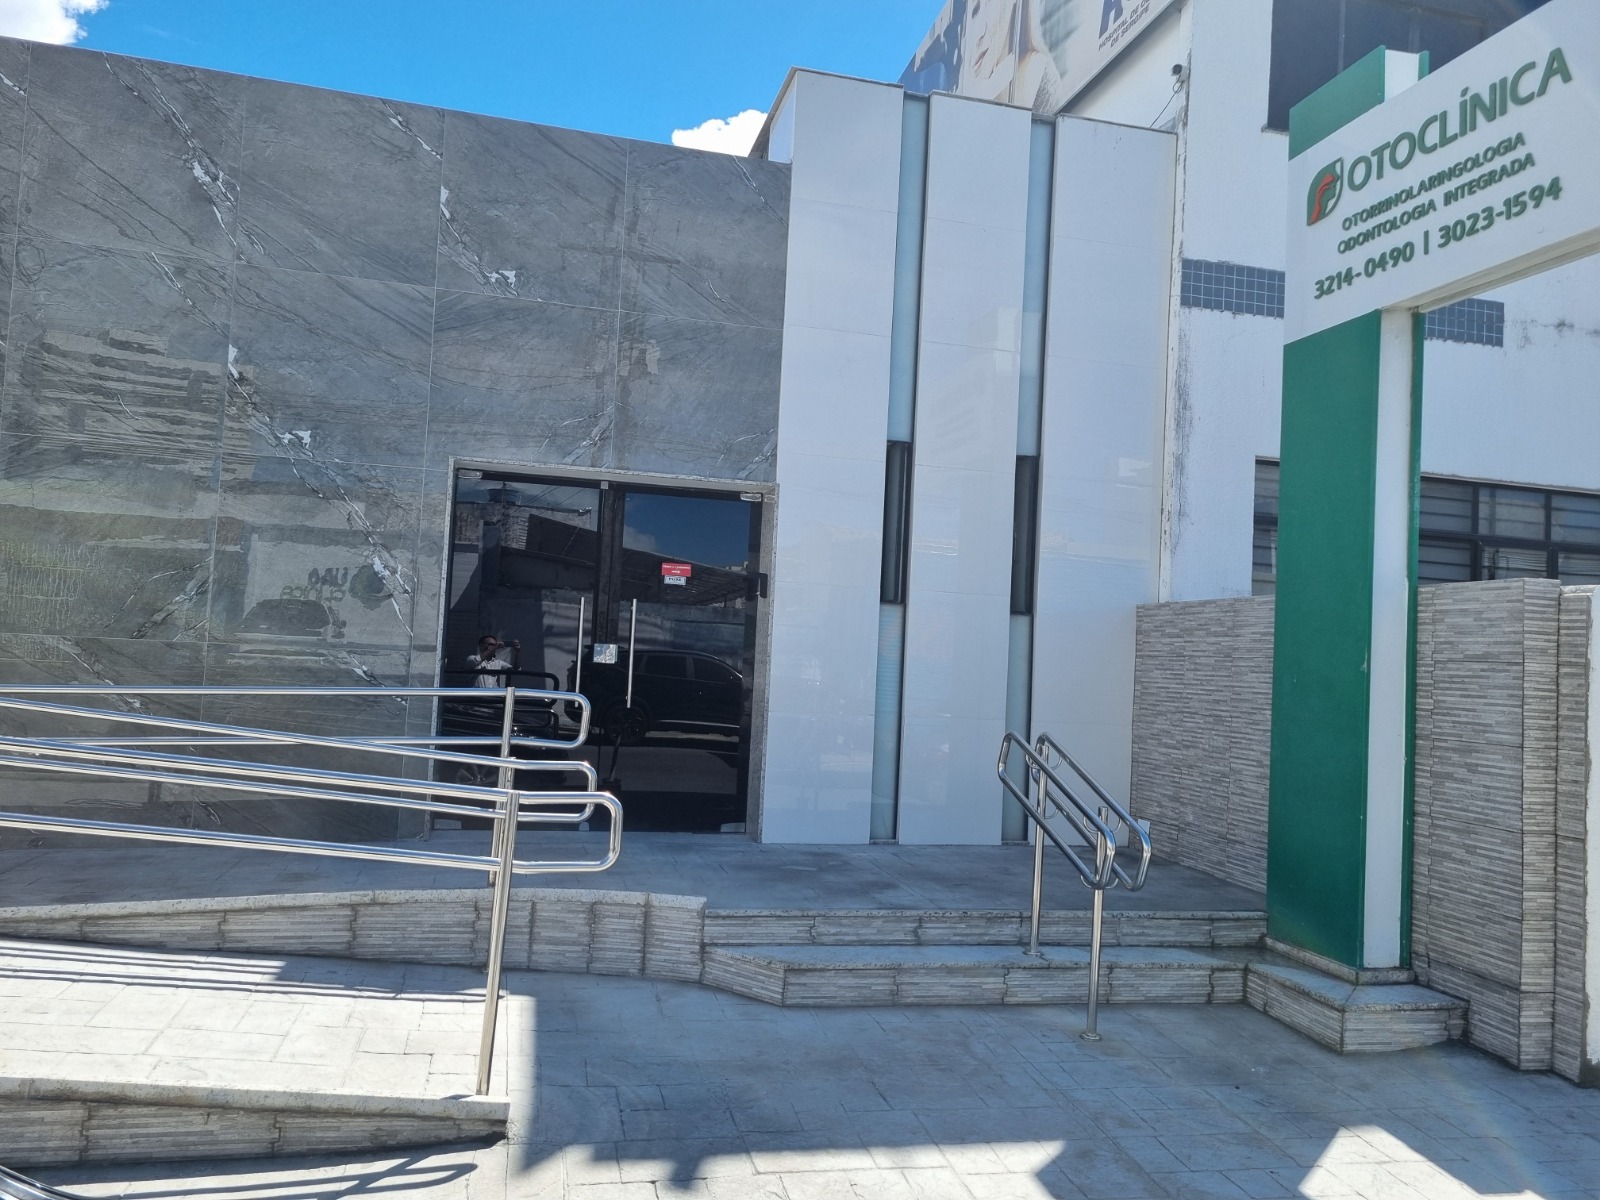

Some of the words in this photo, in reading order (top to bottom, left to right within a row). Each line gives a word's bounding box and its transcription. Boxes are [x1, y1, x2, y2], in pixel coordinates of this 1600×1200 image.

[1098, 17, 1128, 51] HOSPITAL
[1130, 4, 1140, 20] DE
[1110, 33, 1120, 48] DE
[1121, 2, 1150, 38] SERGIPE
[1347, 47, 1573, 191] OTOCLÍNICA
[1337, 199, 1437, 254] ODONTOLOGIA
[1443, 152, 1535, 207] INTEGRADA
[1341, 132, 1526, 231] OTORRINOLARINGOLOGIA
[1437, 176, 1563, 249] 3023-1594
